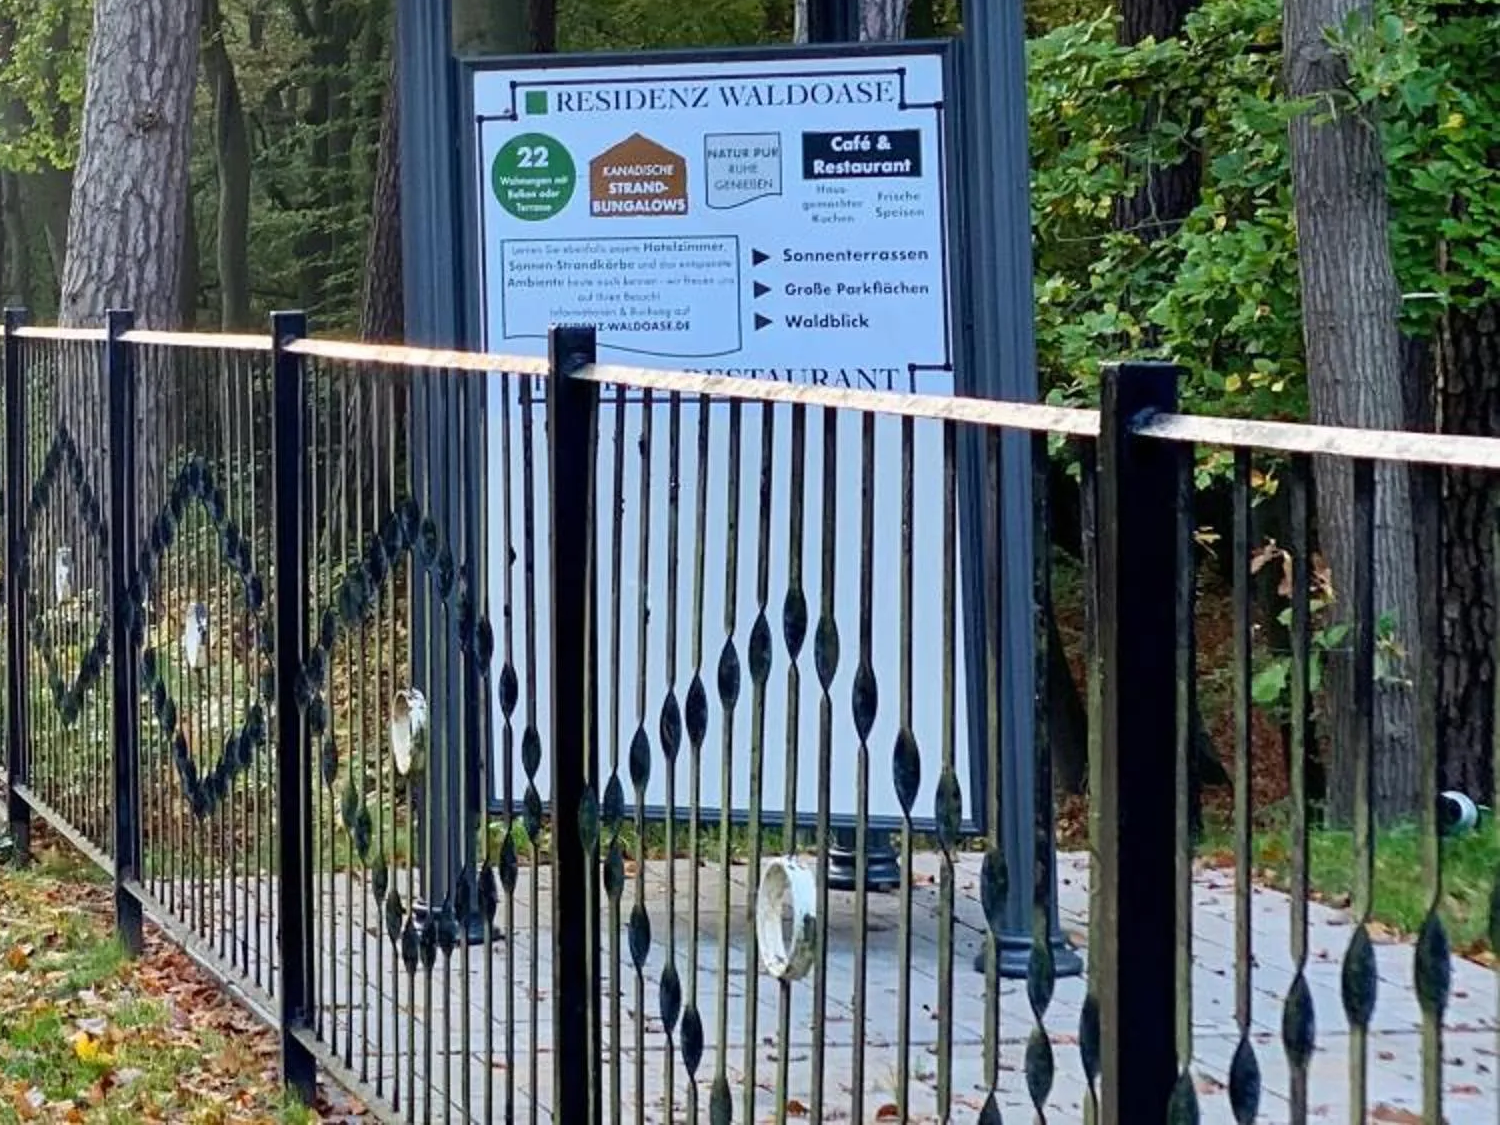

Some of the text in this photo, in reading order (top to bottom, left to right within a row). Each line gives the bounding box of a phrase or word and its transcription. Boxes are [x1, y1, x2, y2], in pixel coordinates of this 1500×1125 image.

[556, 80, 895, 113] RESIDENZ WALDOASE
[831, 135, 892, 152] Café &
[516, 145, 549, 168] 22
[707, 147, 749, 159] NATUR
[603, 164, 675, 176] KANADISCHE
[813, 158, 912, 175] Restaurant
[609, 181, 669, 194] STRAND-
[877, 191, 920, 202] Frische
[592, 198, 685, 213] BUNGALOWS
[875, 206, 925, 219] Speisen
[811, 213, 855, 224] Kuchen
[783, 248, 929, 263] Sonnenterrassen
[784, 280, 930, 297] Große Parkflächen
[785, 314, 870, 329] Waldblick
[683, 367, 900, 393] TAURANT
